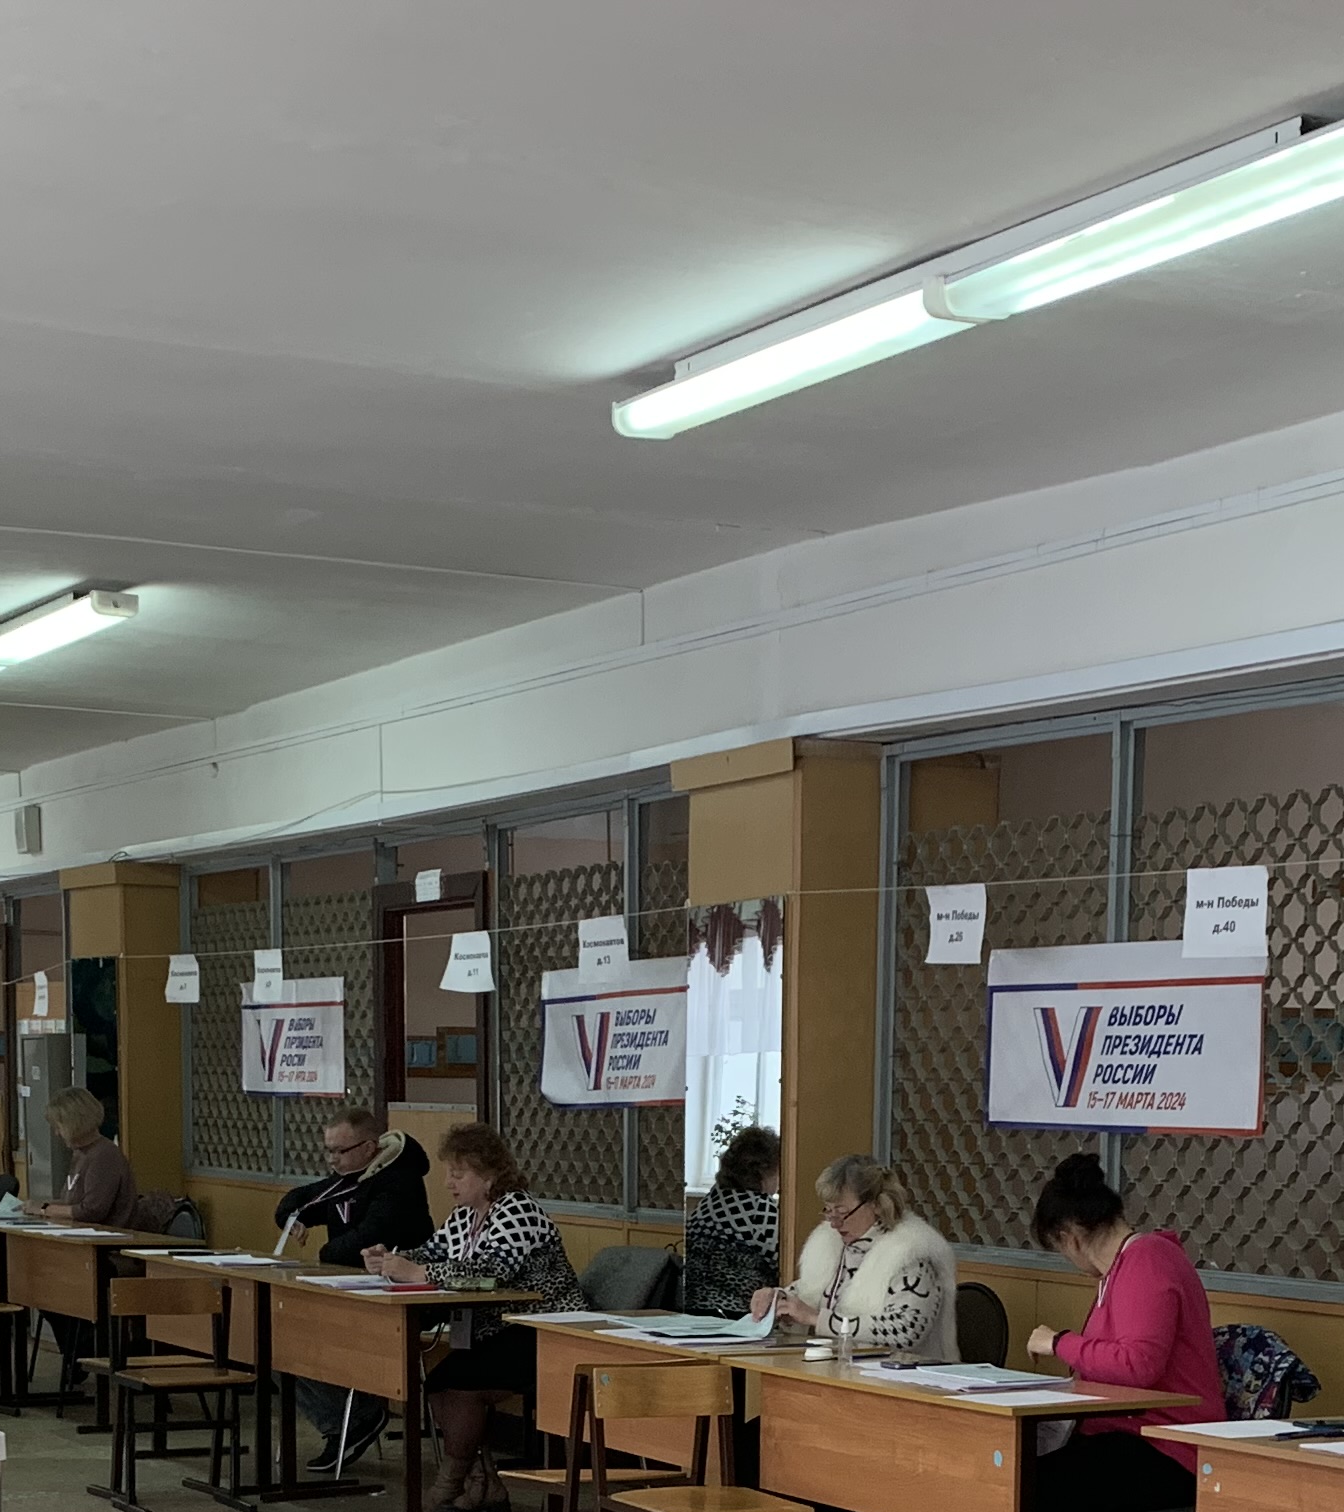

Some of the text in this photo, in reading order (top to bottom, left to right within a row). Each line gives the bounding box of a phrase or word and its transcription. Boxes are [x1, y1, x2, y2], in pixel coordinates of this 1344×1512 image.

[1196, 896, 1259, 909] м-н Победы
[937, 909, 979, 921] м-н Победы
[1212, 920, 1236, 934] д.40
[615, 1008, 657, 1027] ВЫБОРЫ
[1107, 1004, 1184, 1027] ВЫБОРЫ
[610, 1030, 669, 1050] ПРЕЗИДЕНТА
[1100, 1034, 1205, 1058] ПРЕЗИДЕНТА
[607, 1054, 642, 1071] РОССИИ
[619, 1075, 641, 1090] МАРТА
[1093, 1064, 1157, 1085] РОССИИ
[1115, 1092, 1156, 1110] МАРТА
[1157, 1092, 1187, 1110] 2024
